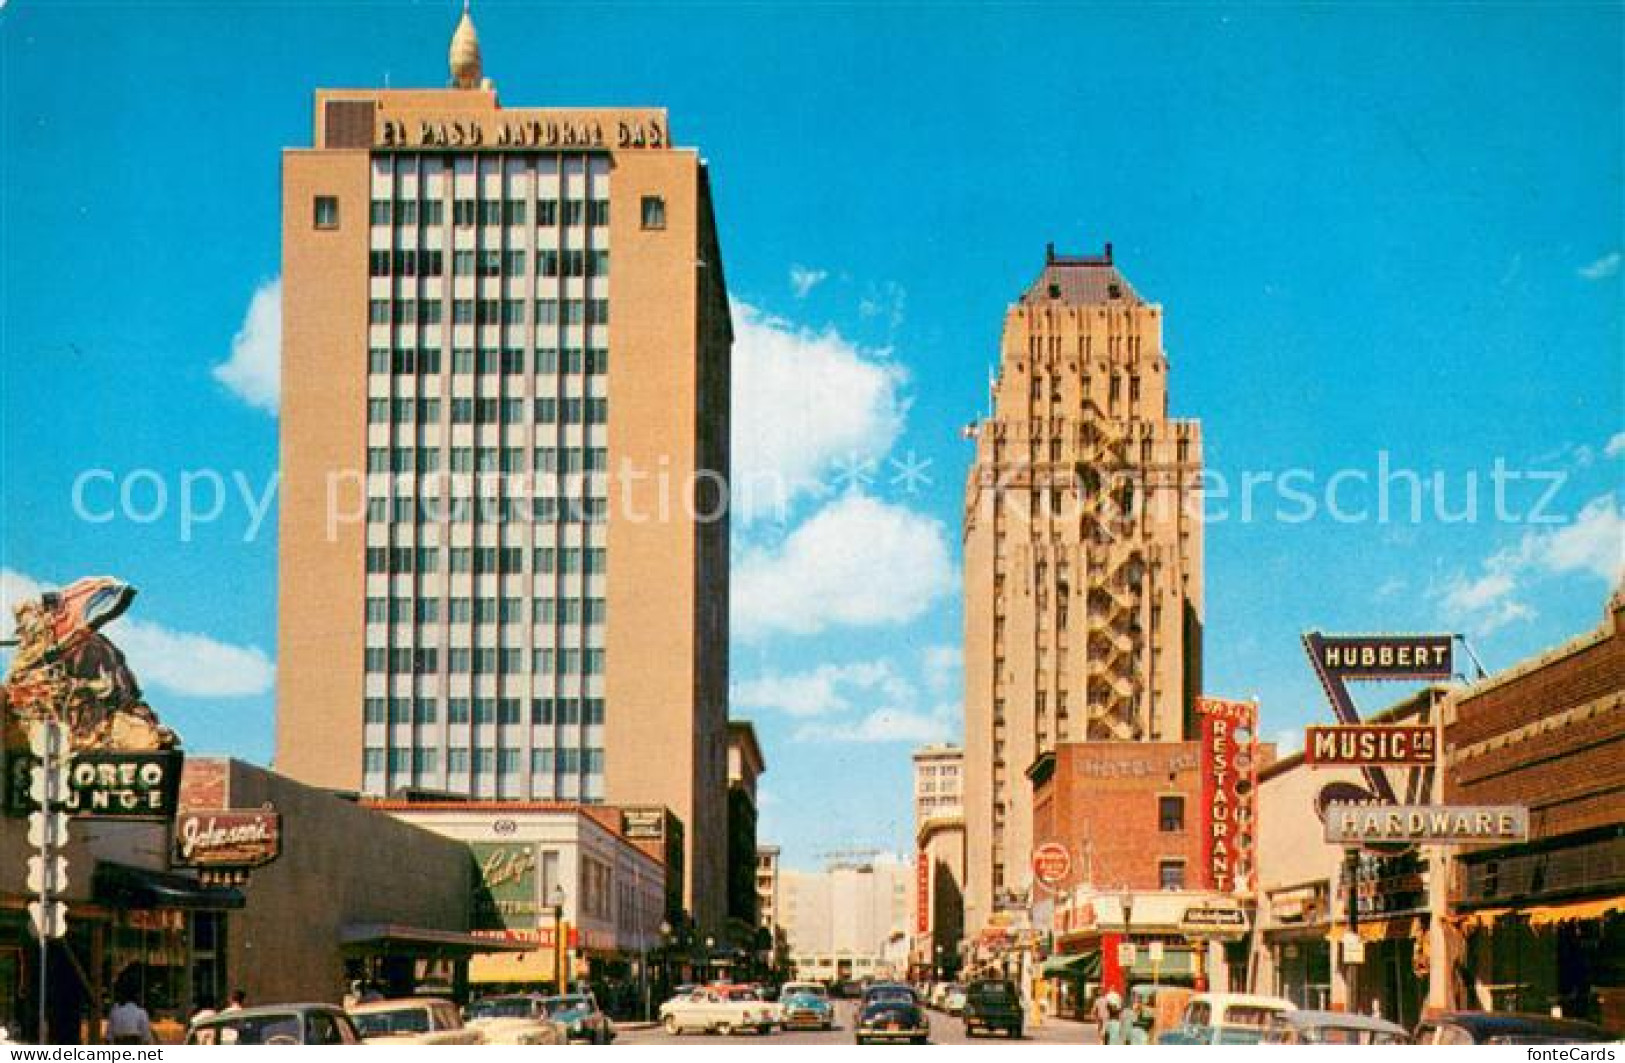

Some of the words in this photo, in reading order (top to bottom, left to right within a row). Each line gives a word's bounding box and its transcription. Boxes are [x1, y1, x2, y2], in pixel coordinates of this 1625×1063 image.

[382, 121, 406, 146] EL
[421, 121, 483, 146] PASO
[497, 121, 602, 146] NATURAL
[618, 120, 664, 148] GAS
[1326, 646, 1448, 667] HUBBERT
[1315, 730, 1407, 759] MUSIC
[1213, 719, 1228, 891] RESTAURANT
[1341, 810, 1514, 837] HARDWARE
